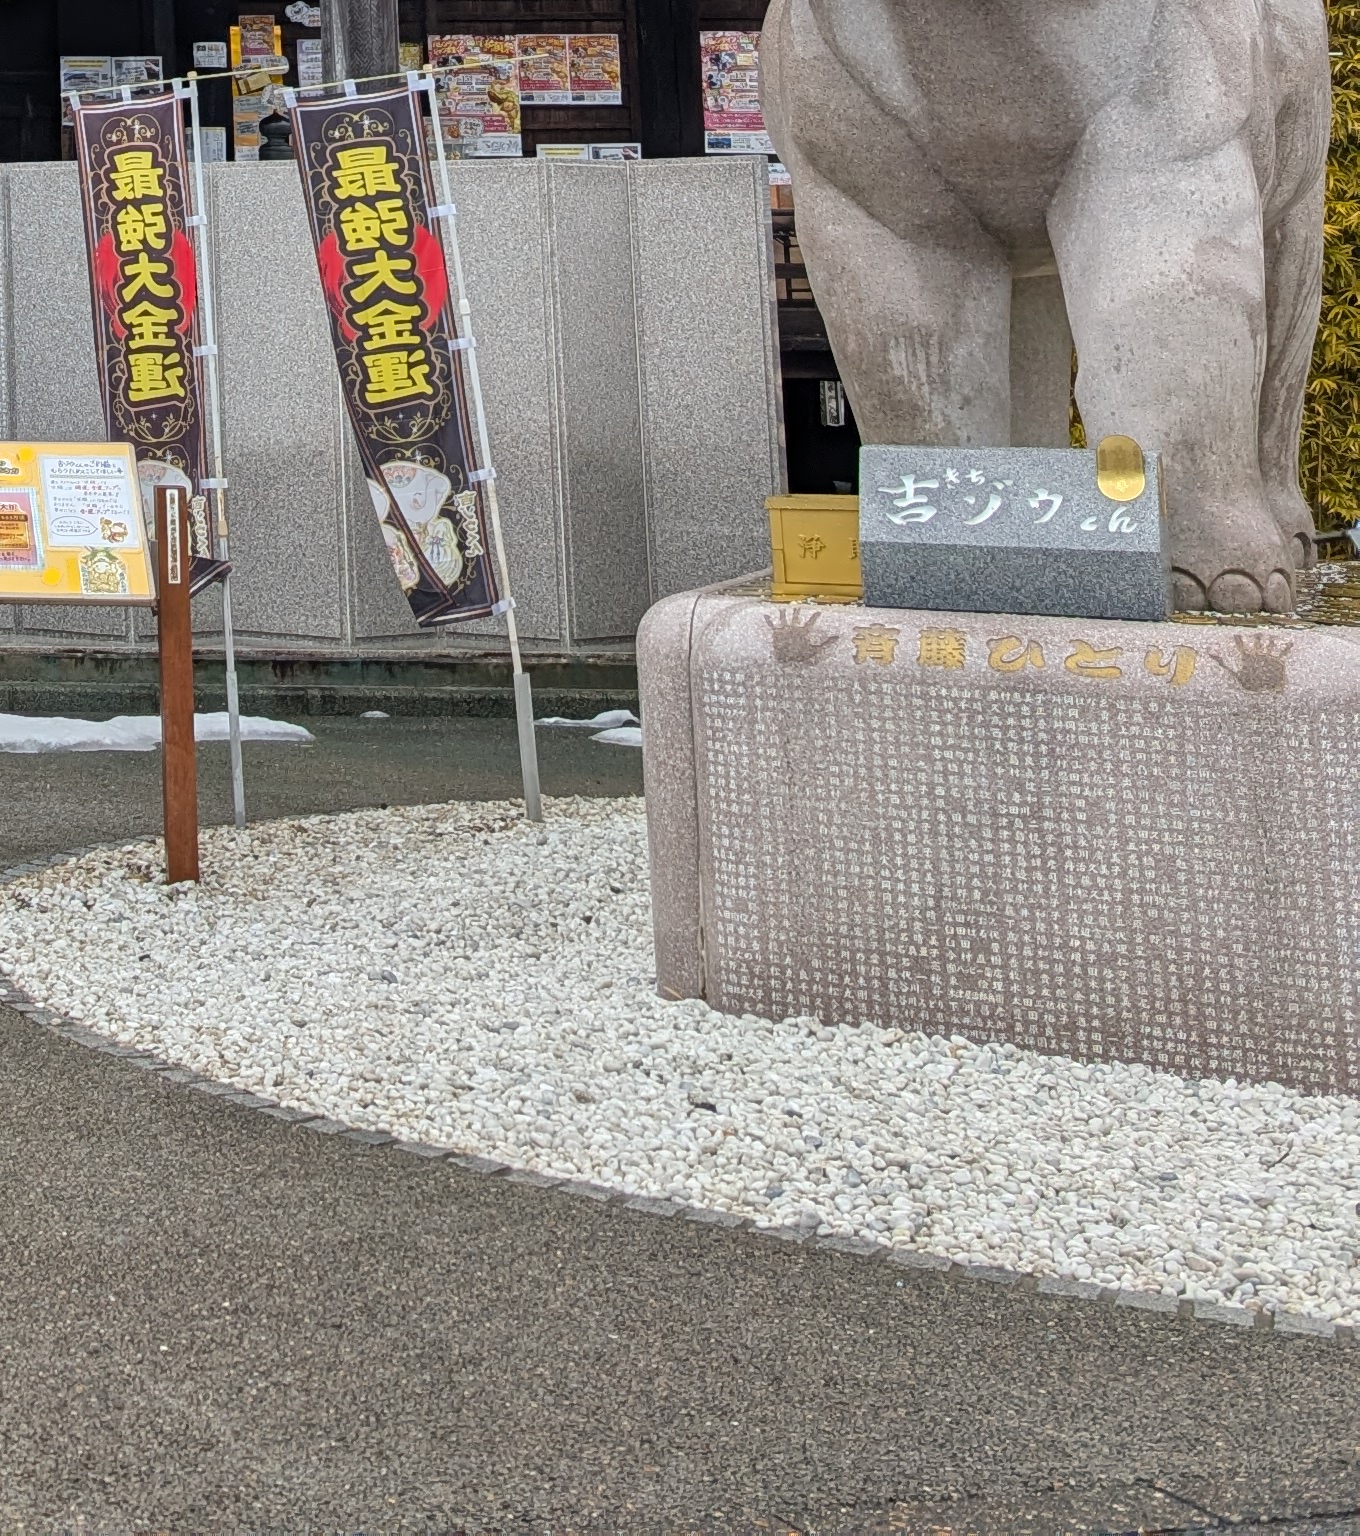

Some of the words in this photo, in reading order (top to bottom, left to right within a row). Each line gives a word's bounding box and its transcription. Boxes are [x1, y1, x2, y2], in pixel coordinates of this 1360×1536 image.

[879, 474, 1137, 534] 吉ゾウくん
[853, 623, 1198, 685] 斉藤ひとり
